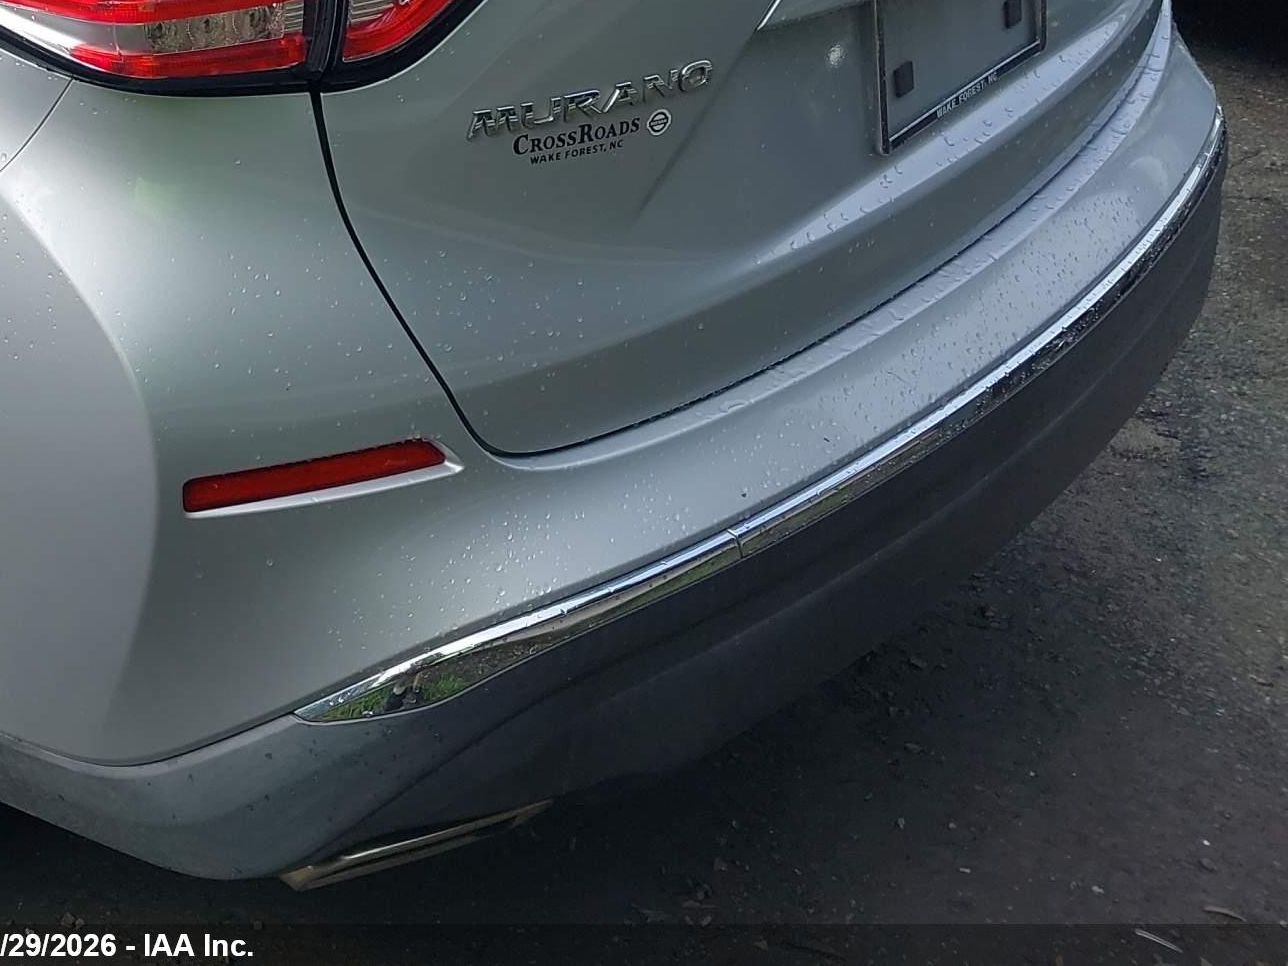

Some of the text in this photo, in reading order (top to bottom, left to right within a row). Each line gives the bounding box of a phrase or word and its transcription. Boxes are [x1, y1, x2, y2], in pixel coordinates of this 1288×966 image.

[466, 59, 713, 140] MURANO
[936, 98, 958, 118] WAKE
[530, 139, 624, 164] WAKE FOREST, NC
